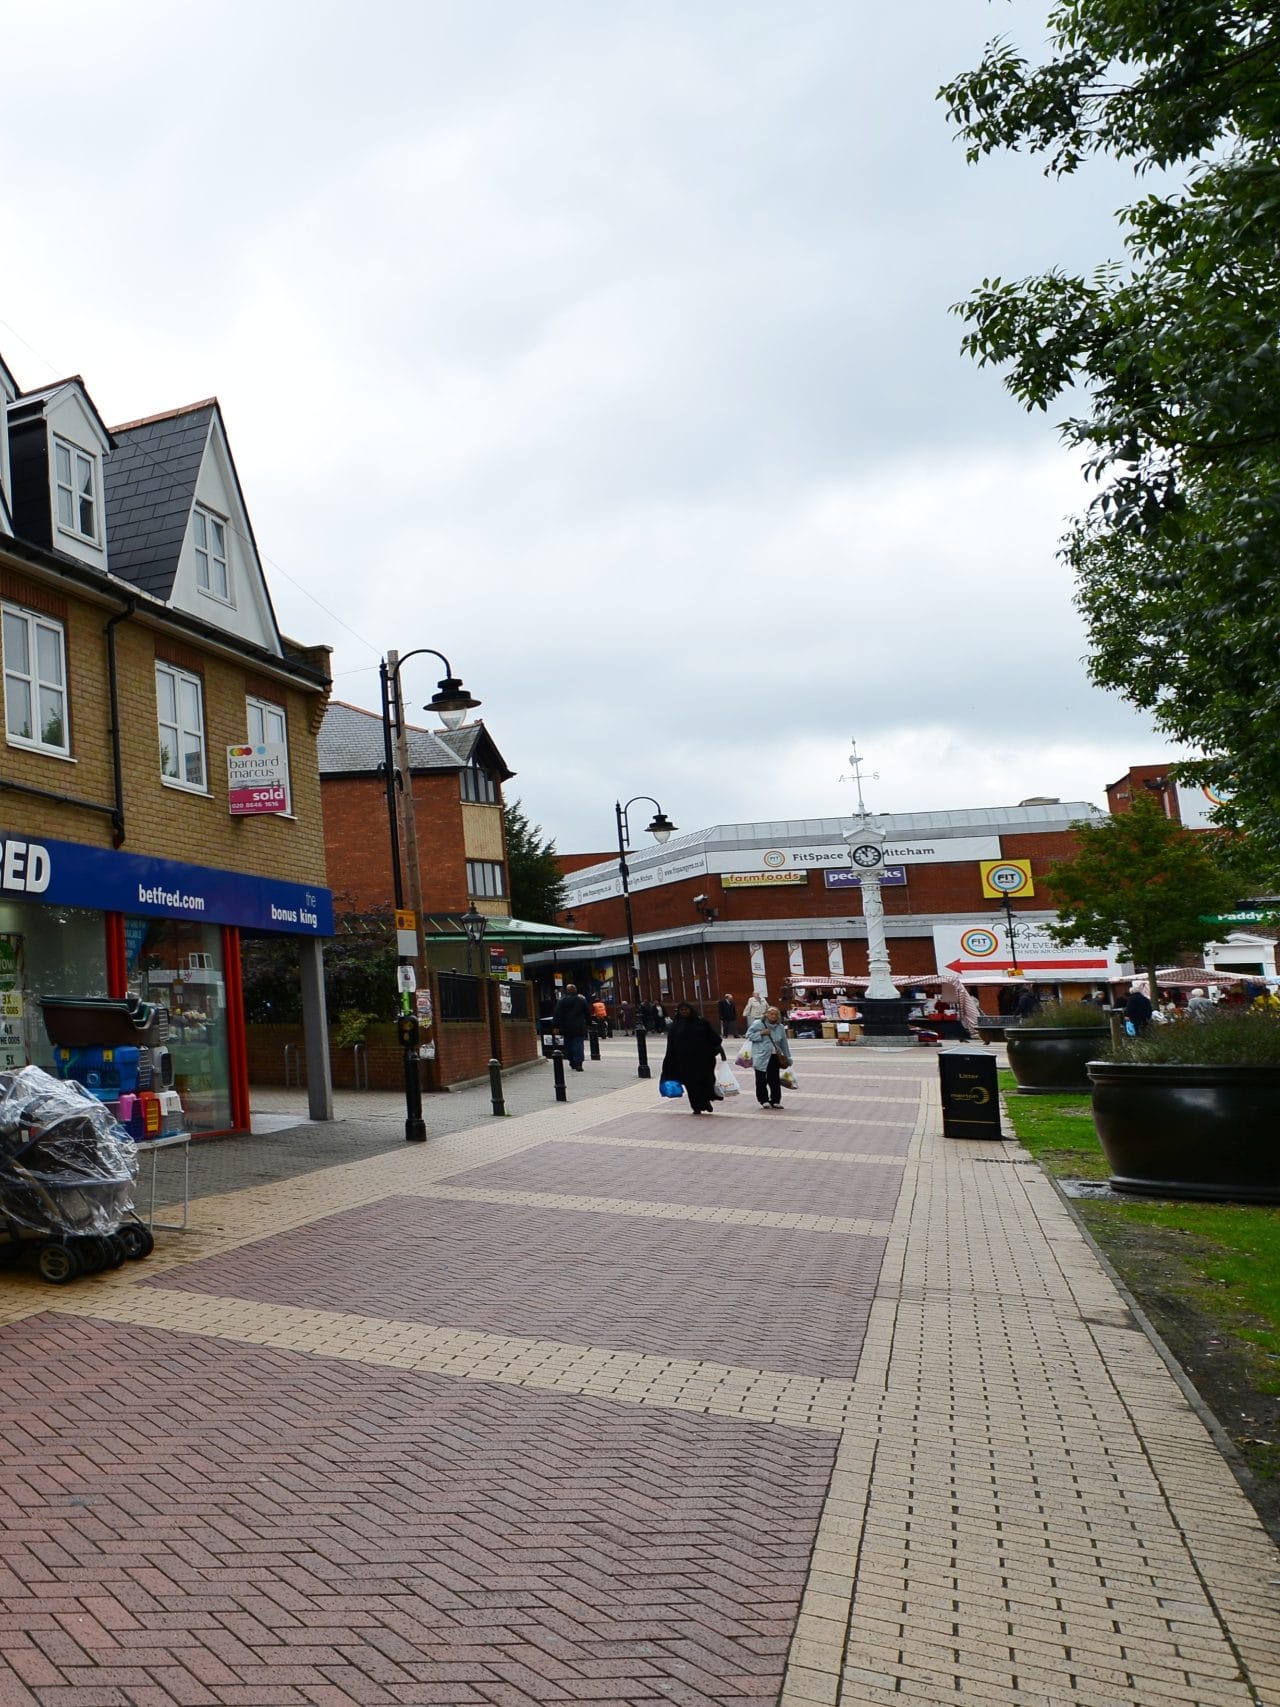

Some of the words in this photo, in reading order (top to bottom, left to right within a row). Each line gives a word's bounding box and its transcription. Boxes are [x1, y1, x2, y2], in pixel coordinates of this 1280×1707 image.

[229, 755, 280, 769] barnard
[230, 768, 275, 779] marcus
[252, 788, 284, 801] sold
[792, 851, 844, 864] FitSpace
[728, 872, 801, 883] farmfoods
[997, 873, 1017, 881] FIT
[138, 883, 205, 911] betfred.com
[271, 904, 298, 924] bonus
[300, 907, 318, 928] king
